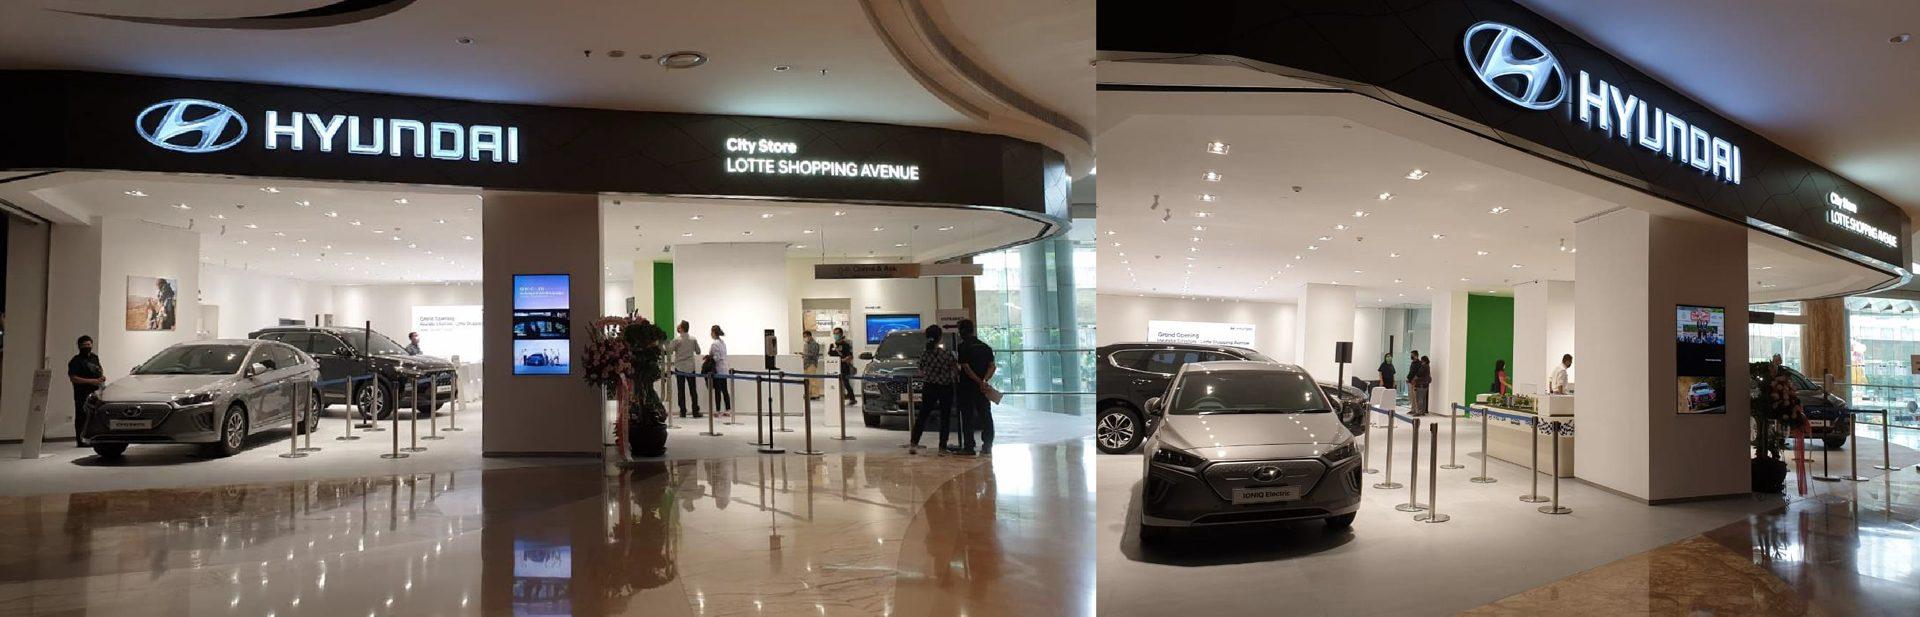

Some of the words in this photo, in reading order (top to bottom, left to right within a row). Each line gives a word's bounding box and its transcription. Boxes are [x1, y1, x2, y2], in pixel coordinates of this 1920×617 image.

[265, 110, 519, 164] HYUNDAI
[1579, 69, 1741, 185] HYUNDAI
[726, 137, 757, 154] City
[758, 139, 798, 154] Store
[726, 157, 775, 174] LOTTE
[778, 159, 858, 178] SHOPPING
[860, 163, 920, 181] AVENUE
[1830, 209, 1850, 229] LOTTE
[1242, 491, 1265, 499] IONIQ
[1265, 490, 1291, 498] Electric
